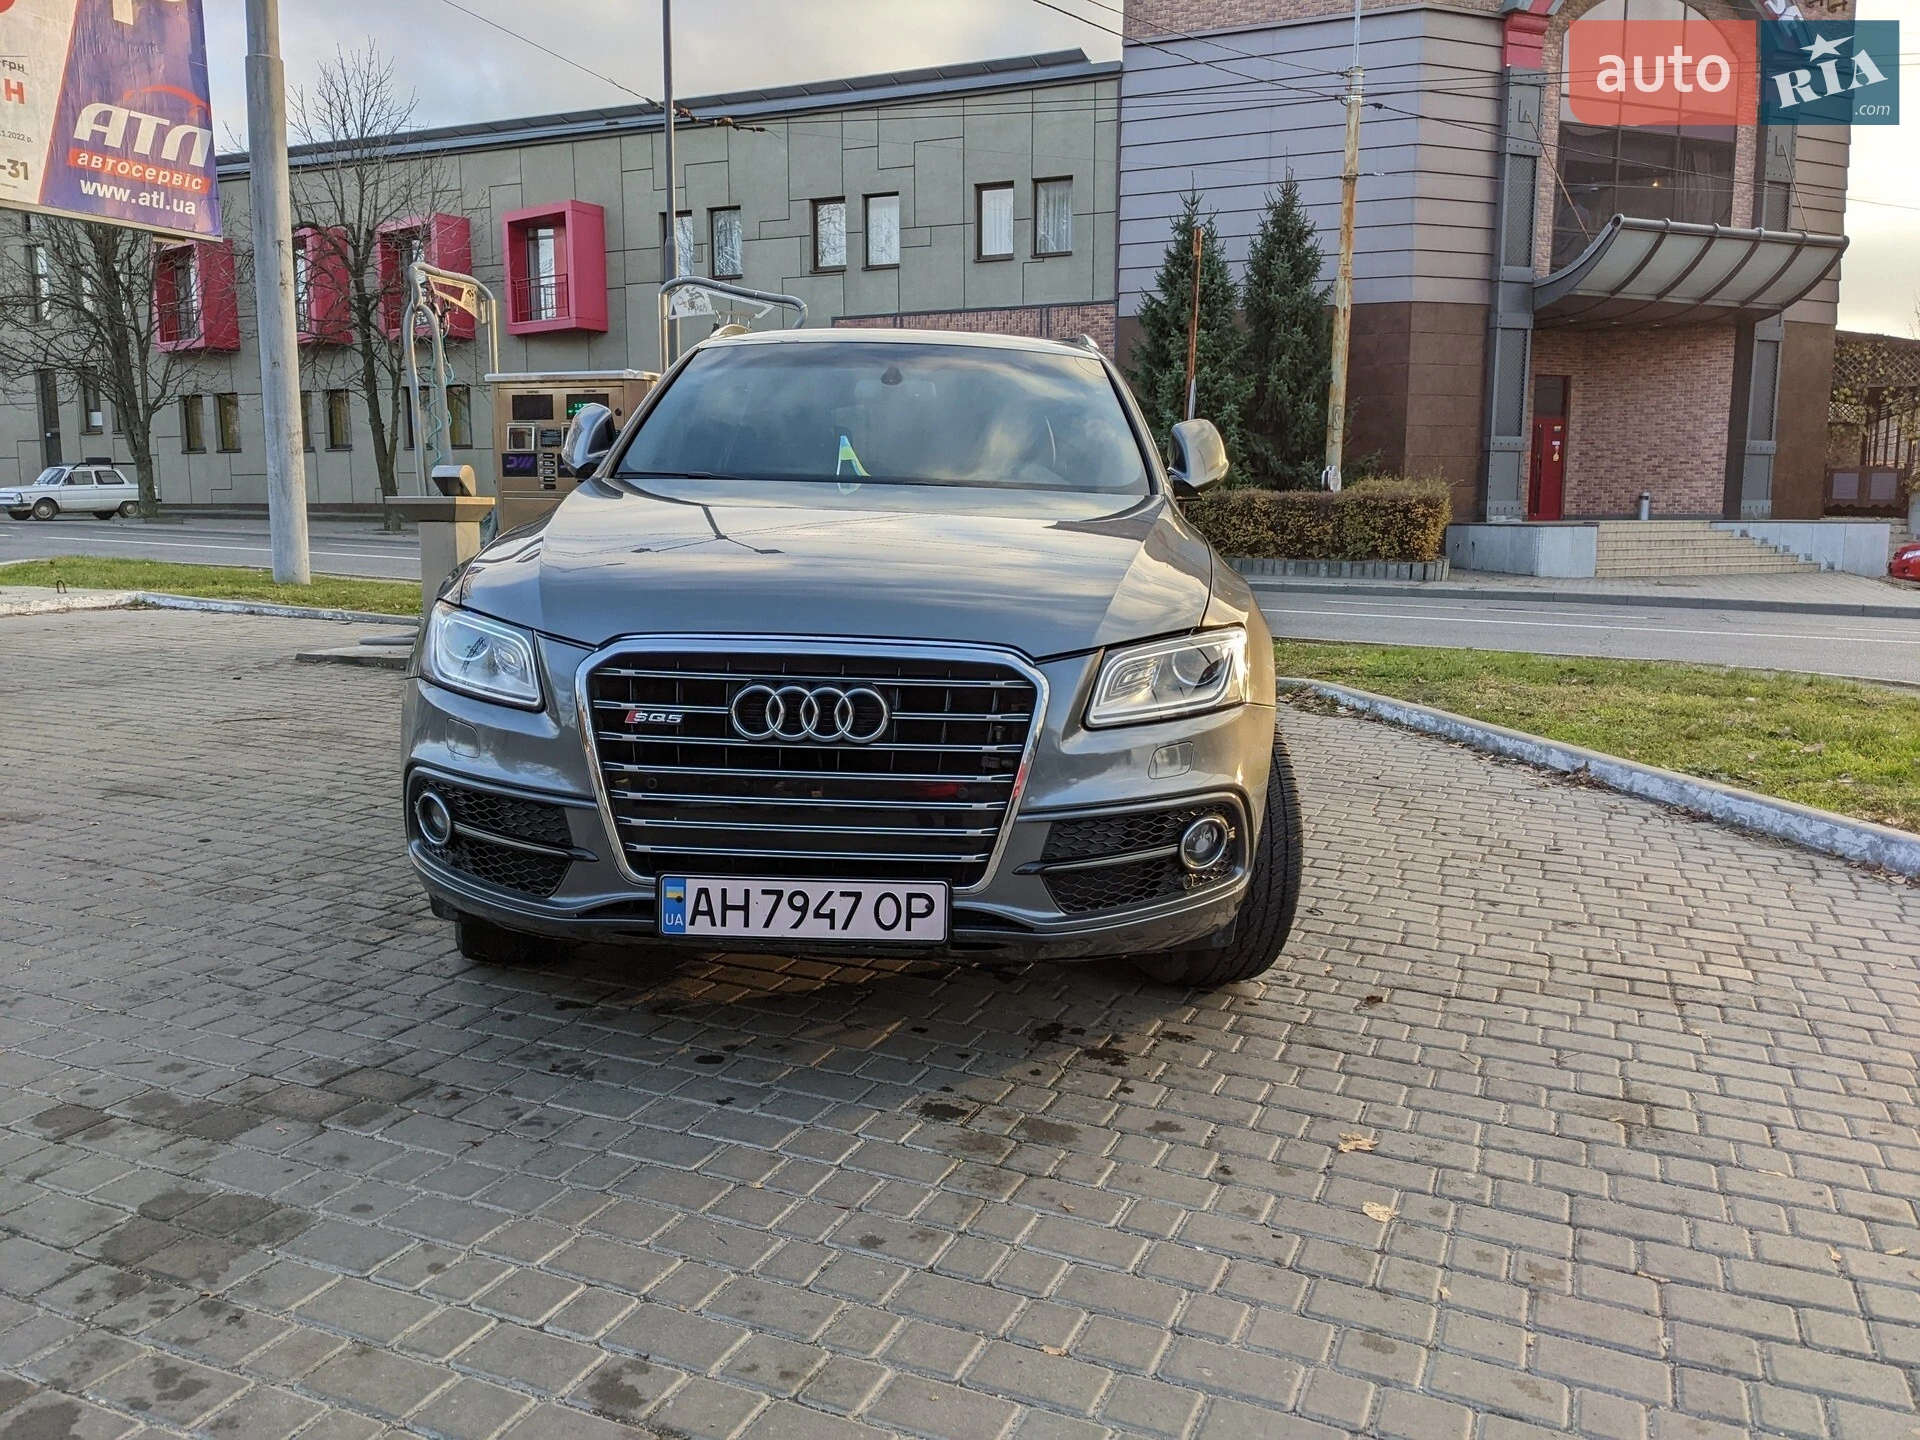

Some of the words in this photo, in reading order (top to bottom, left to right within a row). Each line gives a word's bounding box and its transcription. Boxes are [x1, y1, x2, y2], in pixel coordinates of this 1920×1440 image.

[73, 102, 213, 168] АТЛ
[77, 152, 203, 191] автосервіс
[80, 179, 196, 216] www.atl.ua
[632, 711, 683, 724] SQ5
[665, 913, 685, 927] UA
[688, 887, 750, 929] AH
[760, 889, 863, 931] 7947
[873, 891, 936, 932] OP
